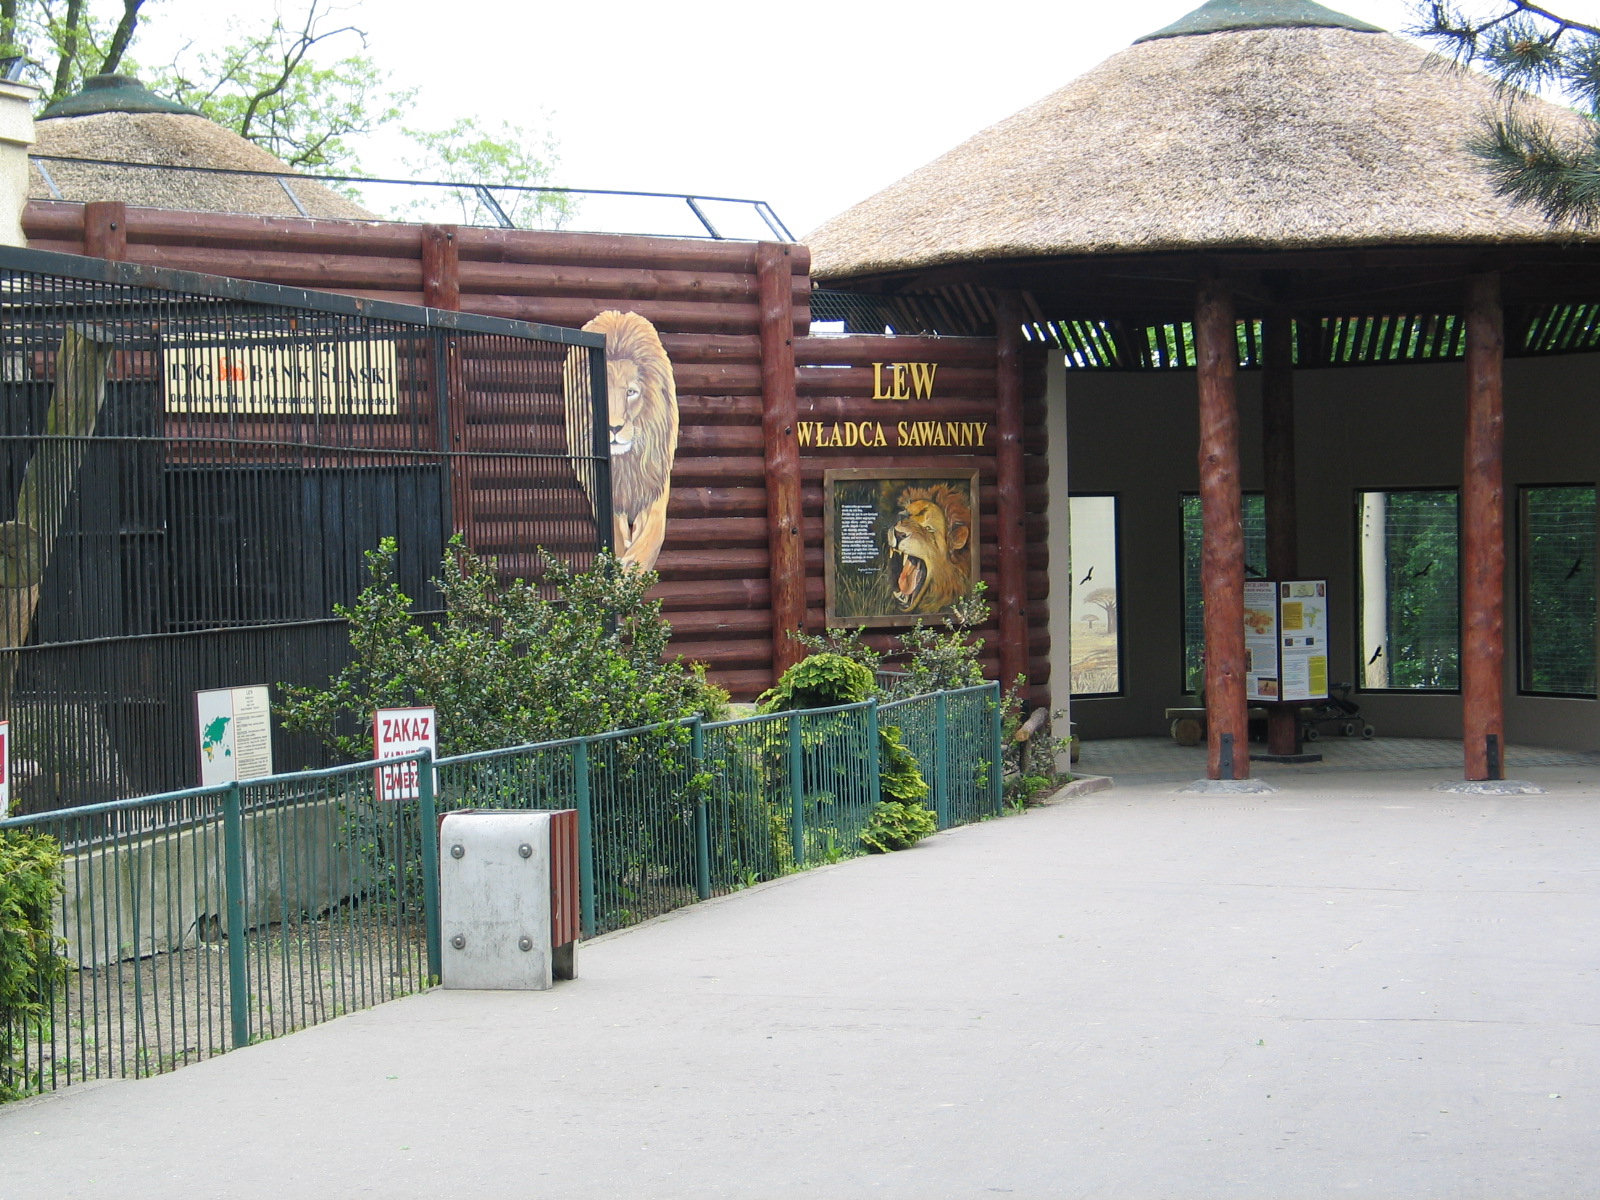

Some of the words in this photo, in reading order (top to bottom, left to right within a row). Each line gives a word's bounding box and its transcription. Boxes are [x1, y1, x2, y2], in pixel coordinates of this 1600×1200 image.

[171, 363, 212, 382] ING
[253, 364, 311, 383] BANK
[872, 362, 937, 401] LEW
[797, 421, 887, 447] WŁADCA
[898, 421, 988, 447] SAWANNY
[383, 718, 429, 743] ZAKAZ
